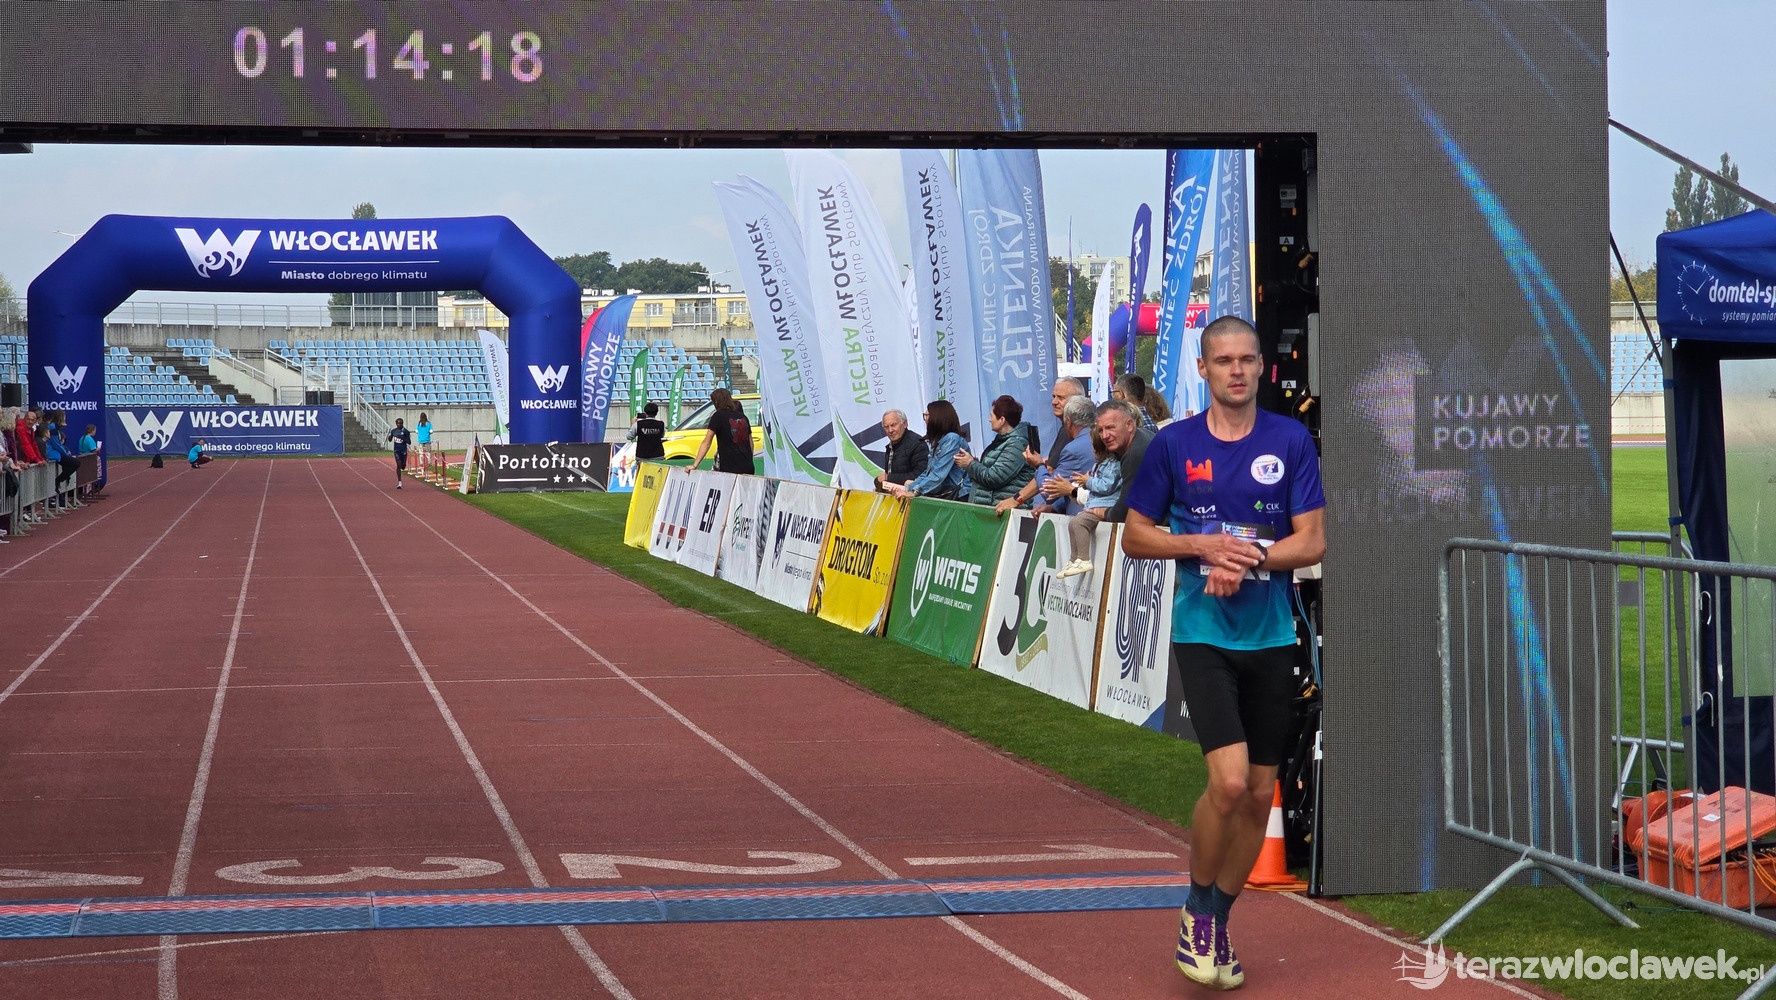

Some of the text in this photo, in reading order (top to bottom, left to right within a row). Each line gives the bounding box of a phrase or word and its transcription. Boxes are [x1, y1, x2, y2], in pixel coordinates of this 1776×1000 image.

[233, 27, 543, 82] 01:14:18
[269, 230, 438, 251] WŁOCŁAWEK
[281, 269, 427, 283] Miasto dobrego klimatu
[1722, 311, 1751, 323] systemy
[1156, 278, 1180, 393] WIENIEC
[582, 341, 603, 418] KUJAWY
[592, 332, 620, 421] POMORZE
[37, 401, 98, 410] WŁOCŁAWEK
[520, 400, 578, 409] WŁOCŁAWEK
[1433, 394, 1559, 418] KUJAWY
[190, 410, 319, 428] WŁOCŁAWEK
[200, 441, 311, 452] Miasto dobrego klimatu
[1433, 424, 1592, 450] POMORZE
[499, 453, 592, 470] Portofino
[828, 536, 879, 580] DROGTOM
[934, 556, 982, 594] WATIS
[1107, 684, 1151, 711] WŁOCŁAWEK
[560, 850, 841, 879] 2
[904, 844, 1180, 867] 1
[215, 856, 504, 884] 3
